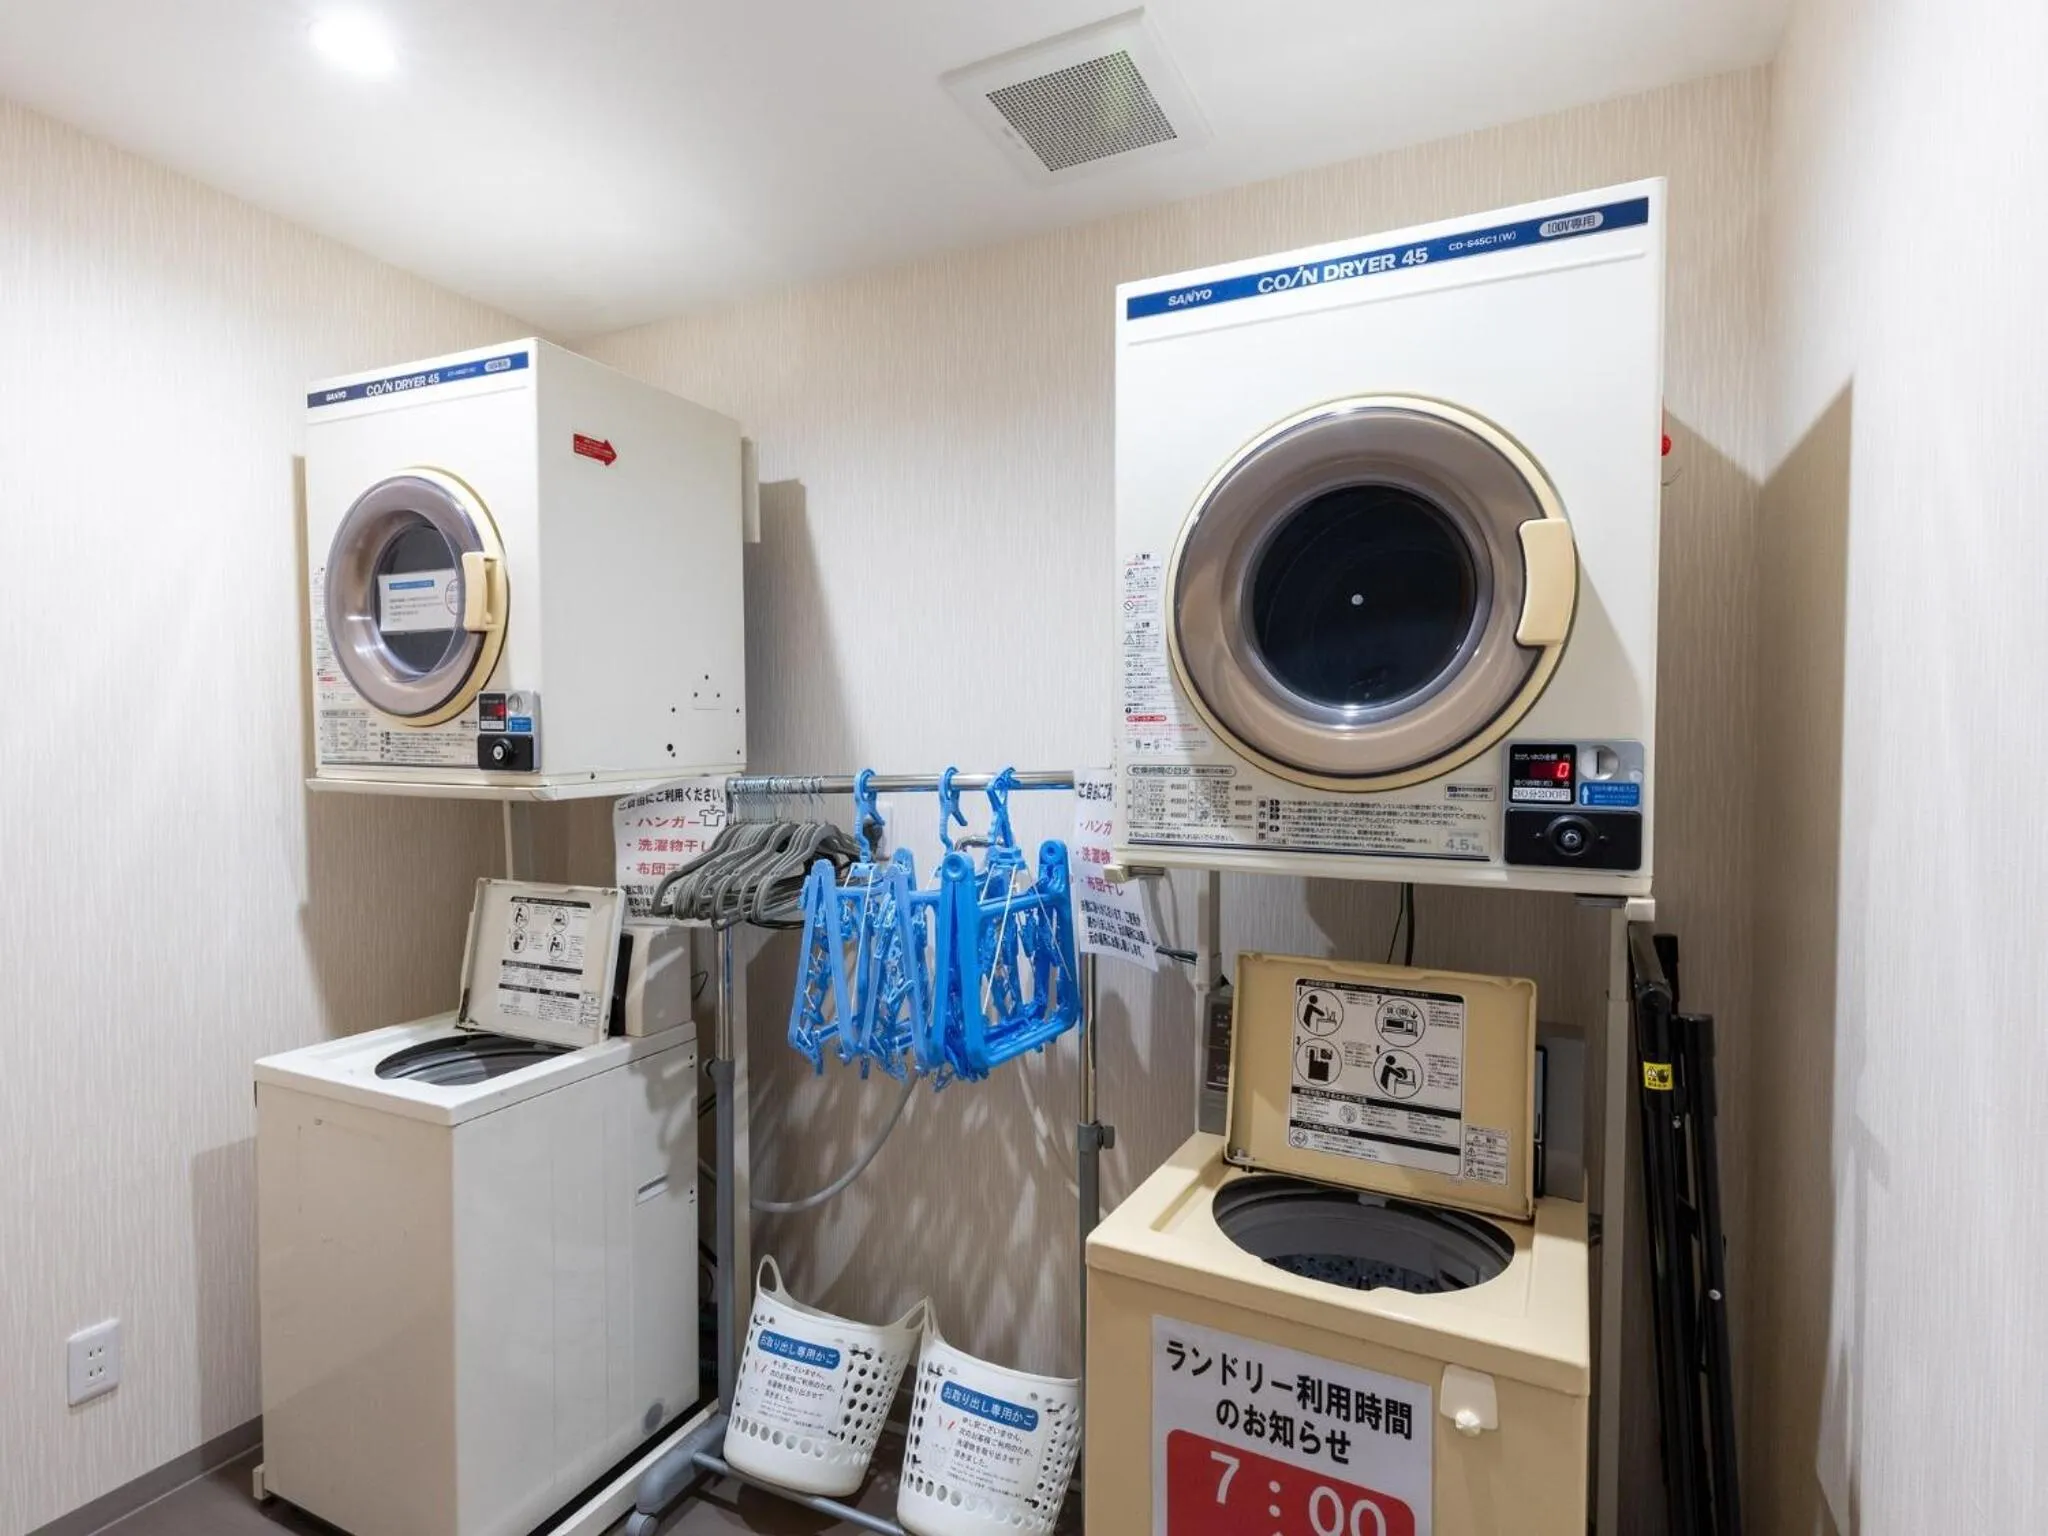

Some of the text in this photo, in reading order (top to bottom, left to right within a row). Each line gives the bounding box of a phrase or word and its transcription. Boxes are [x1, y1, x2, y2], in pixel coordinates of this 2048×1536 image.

[1168, 289, 1212, 306] SANYO
[1324, 253, 1396, 282] DRYER
[1402, 247, 1428, 265] 45
[395, 375, 427, 393] DRYER
[428, 372, 440, 386] 45
[1557, 762, 1570, 778] 0
[760, 1335, 839, 1366] お取り出し専用かご
[943, 1386, 1036, 1427] お取り出し専用かご
[1166, 1340, 1413, 1440] ランドリー利用時間
[1216, 1399, 1351, 1464] のお知らせ
